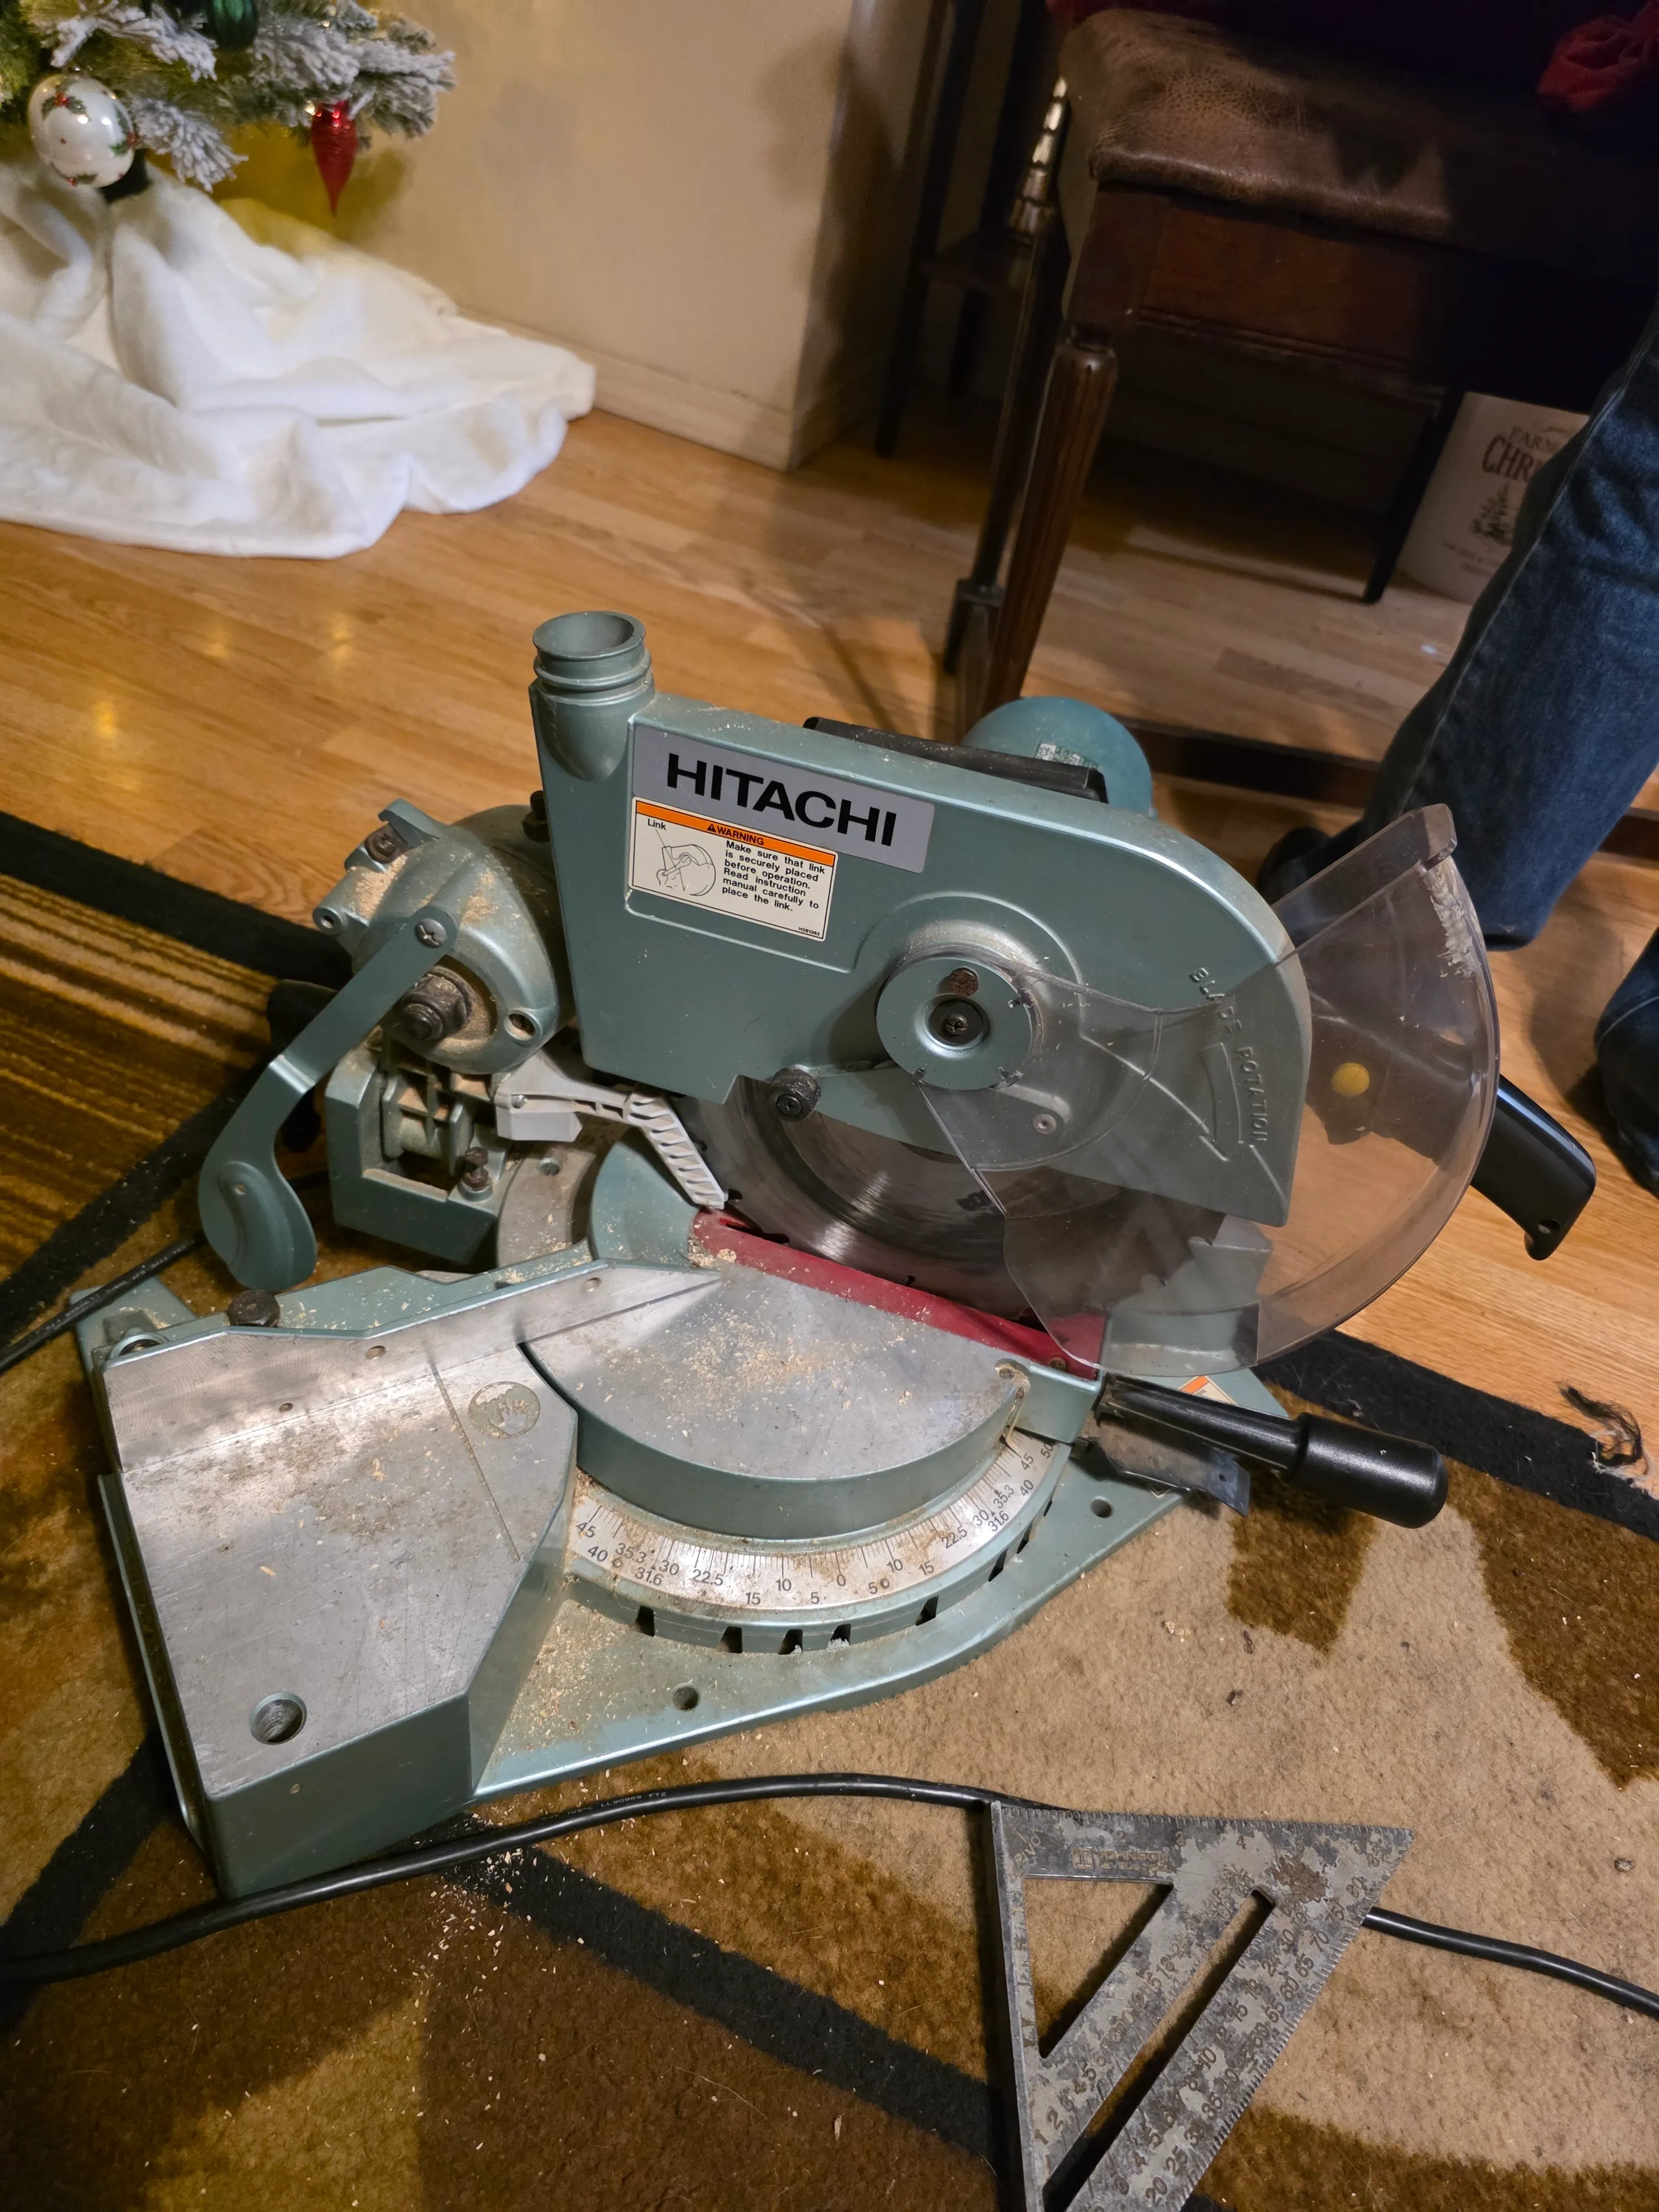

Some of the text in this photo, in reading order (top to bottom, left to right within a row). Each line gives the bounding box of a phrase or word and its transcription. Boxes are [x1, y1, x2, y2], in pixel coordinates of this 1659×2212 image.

[666, 753, 898, 847] HITACHI
[648, 818, 666, 831] Link
[717, 826, 764, 846] WARNING
[726, 840, 825, 874] Make sure that link
[726, 849, 818, 881] is securely placed
[724, 859, 810, 889] before operation.
[724, 867, 806, 896] Read instruction
[722, 886, 793, 911] place the link.
[723, 878, 819, 909] manual carefully to
[1237, 1046, 1268, 1142] ROTATION
[1040, 1443, 1054, 1459] 50
[576, 1453, 1034, 1605] 45 40 35.3 31.6 30 22.5 15 10 5 0 5 10 15 22.5 30 31.6 35.3 40 45
[1236, 1834, 1246, 1850] 4
[1145, 2176, 1167, 2206] 20
[1165, 2145, 1188, 2177] 25
[1202, 2091, 1223, 2120] 35
[1279, 1975, 1300, 2001] 60
[1295, 1953, 1314, 1978] 65
[1309, 1928, 1329, 1953] 70
[1327, 1898, 1345, 1923] 75
[1345, 1875, 1364, 1899] 80
[1185, 2074, 1198, 2091] 8
[1197, 2046, 1216, 2069] 10
[1047, 2106, 1063, 2130] 2
[1081, 2063, 1096, 2081] 5
